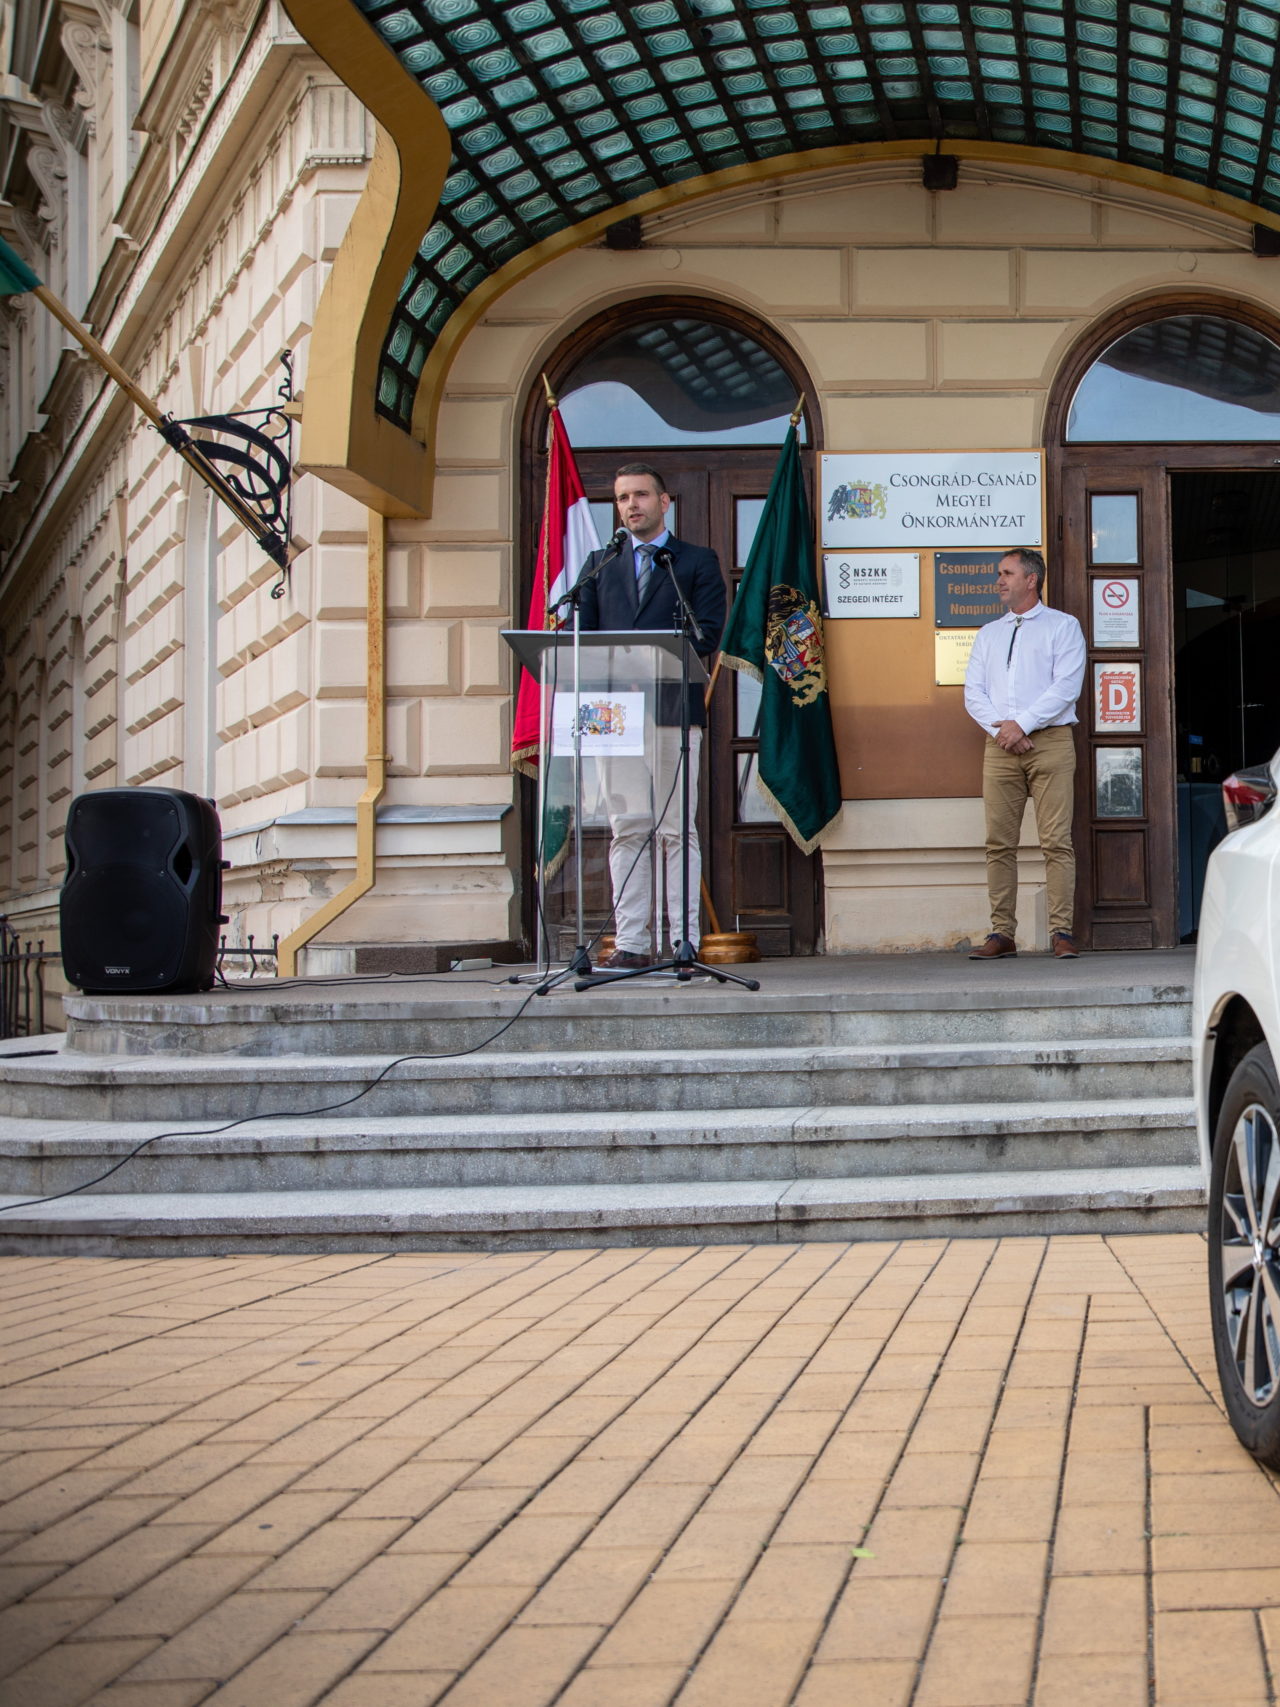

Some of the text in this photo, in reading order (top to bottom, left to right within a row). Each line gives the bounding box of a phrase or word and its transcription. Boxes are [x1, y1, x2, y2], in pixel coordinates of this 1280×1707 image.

[890, 471, 1037, 487] CSONGRÁD-CSANÁD
[936, 494, 991, 507] MEGYEI
[901, 512, 1025, 528] ÖNKORMÁNYZAT
[853, 568, 887, 577] NSZKK
[940, 562, 994, 574] Csongrád
[837, 594, 904, 604] SZEGEDI INTÉZET
[950, 602, 1005, 615] Nonprofit
[1108, 683, 1128, 711] D
